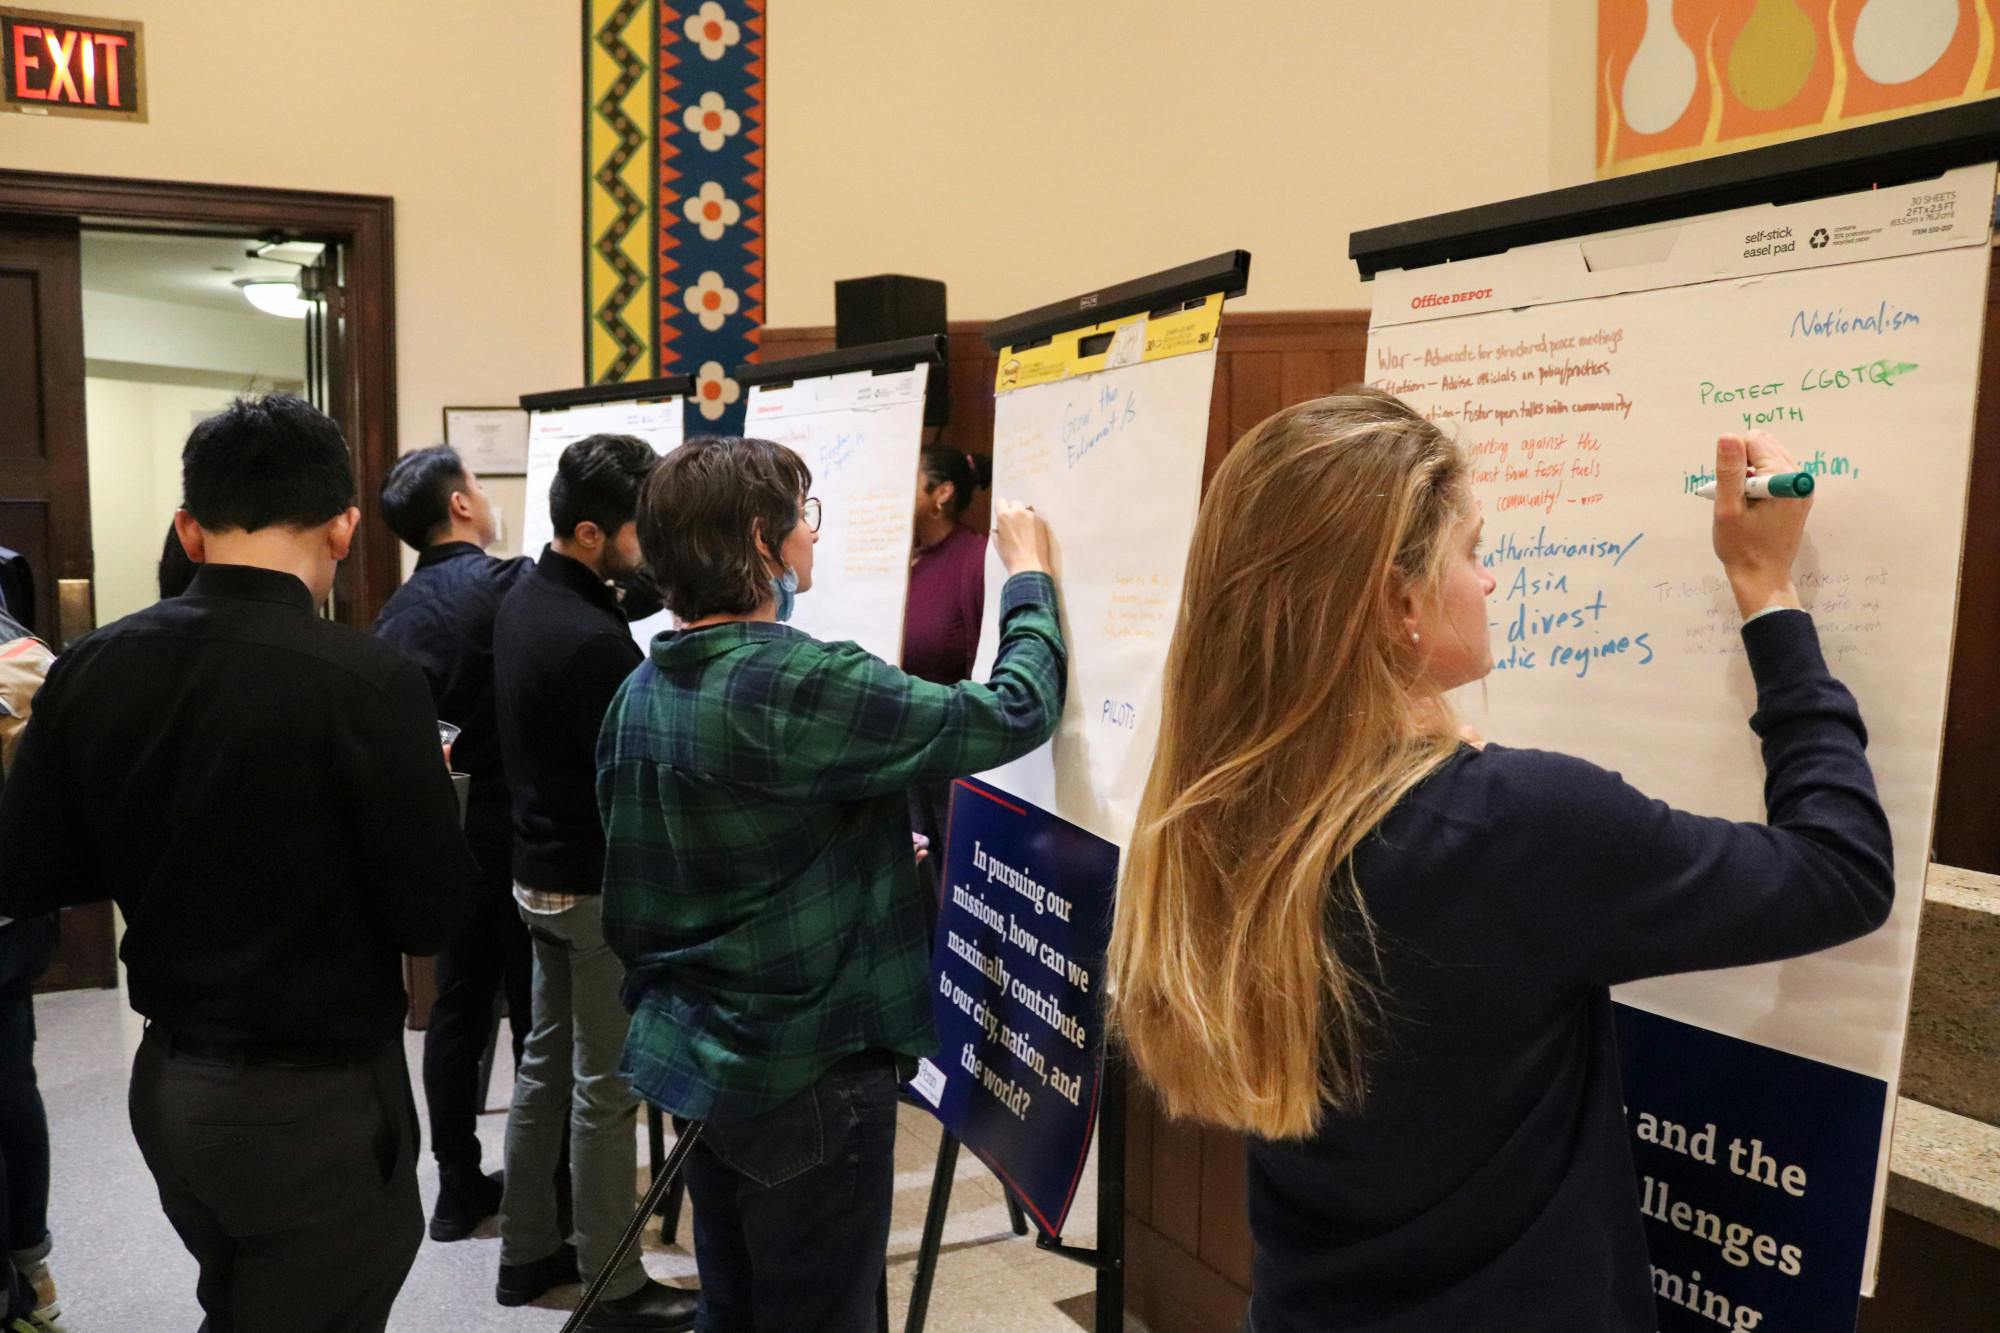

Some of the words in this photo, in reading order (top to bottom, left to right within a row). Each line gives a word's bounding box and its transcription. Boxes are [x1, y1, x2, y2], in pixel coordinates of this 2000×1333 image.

[12, 24, 129, 107] EXIT
[1911, 196, 1922, 206] 30
[1924, 191, 1957, 205] SHEETS
[1743, 244, 1772, 258] easel
[1774, 240, 1796, 257] pad
[1745, 226, 1793, 244] self-stick
[1411, 294, 1450, 309] Office
[1452, 288, 1493, 303] DEPOT
[1790, 300, 1920, 338] Nationalism
[1378, 347, 1410, 370] War
[1424, 344, 1476, 367] Advocate
[1478, 343, 1493, 360] for
[1549, 337, 1575, 359] peace
[1578, 328, 1623, 354] meetings
[1371, 377, 1425, 396] Iflation
[1441, 374, 1473, 392] Advise
[1699, 382, 1784, 405] PROTECT
[1801, 360, 1895, 392] LGBTQ
[1463, 400, 1493, 422] Foster
[1494, 409, 1519, 427] open
[1520, 400, 1545, 418] talks
[1571, 392, 1633, 420] community
[1743, 407, 1803, 429] YOUTH
[1520, 433, 1567, 460] against
[1577, 432, 1602, 451] the
[1504, 463, 1529, 482] from
[1534, 460, 1566, 478] fossil
[1571, 458, 1601, 478] fuels
[1496, 480, 1564, 514] community!
[1483, 525, 1645, 568] uthoritarianism/
[1506, 566, 1568, 601] Asia
[1507, 590, 1607, 643] divest
[1549, 632, 1653, 679] regimes
[972, 840, 988, 872] In
[986, 855, 1046, 915] pursuing
[1046, 891, 1073, 923] our
[952, 883, 1006, 943] missions,
[1008, 913, 1040, 957] how
[1039, 942, 1065, 976] can
[1067, 959, 1090, 993] we
[946, 930, 1012, 997] maximally
[1011, 977, 1087, 1049] contribute
[939, 970, 953, 998] to
[952, 985, 975, 1015] our
[973, 999, 999, 1045] city,
[999, 1023, 1049, 1086] nation,
[1050, 1065, 1082, 1106] and
[960, 1042, 984, 1080] the
[982, 1065, 1032, 1121] world?
[1636, 1111, 1718, 1166] and
[1728, 1136, 1808, 1198] the
[1639, 1175, 1803, 1277] llenges
